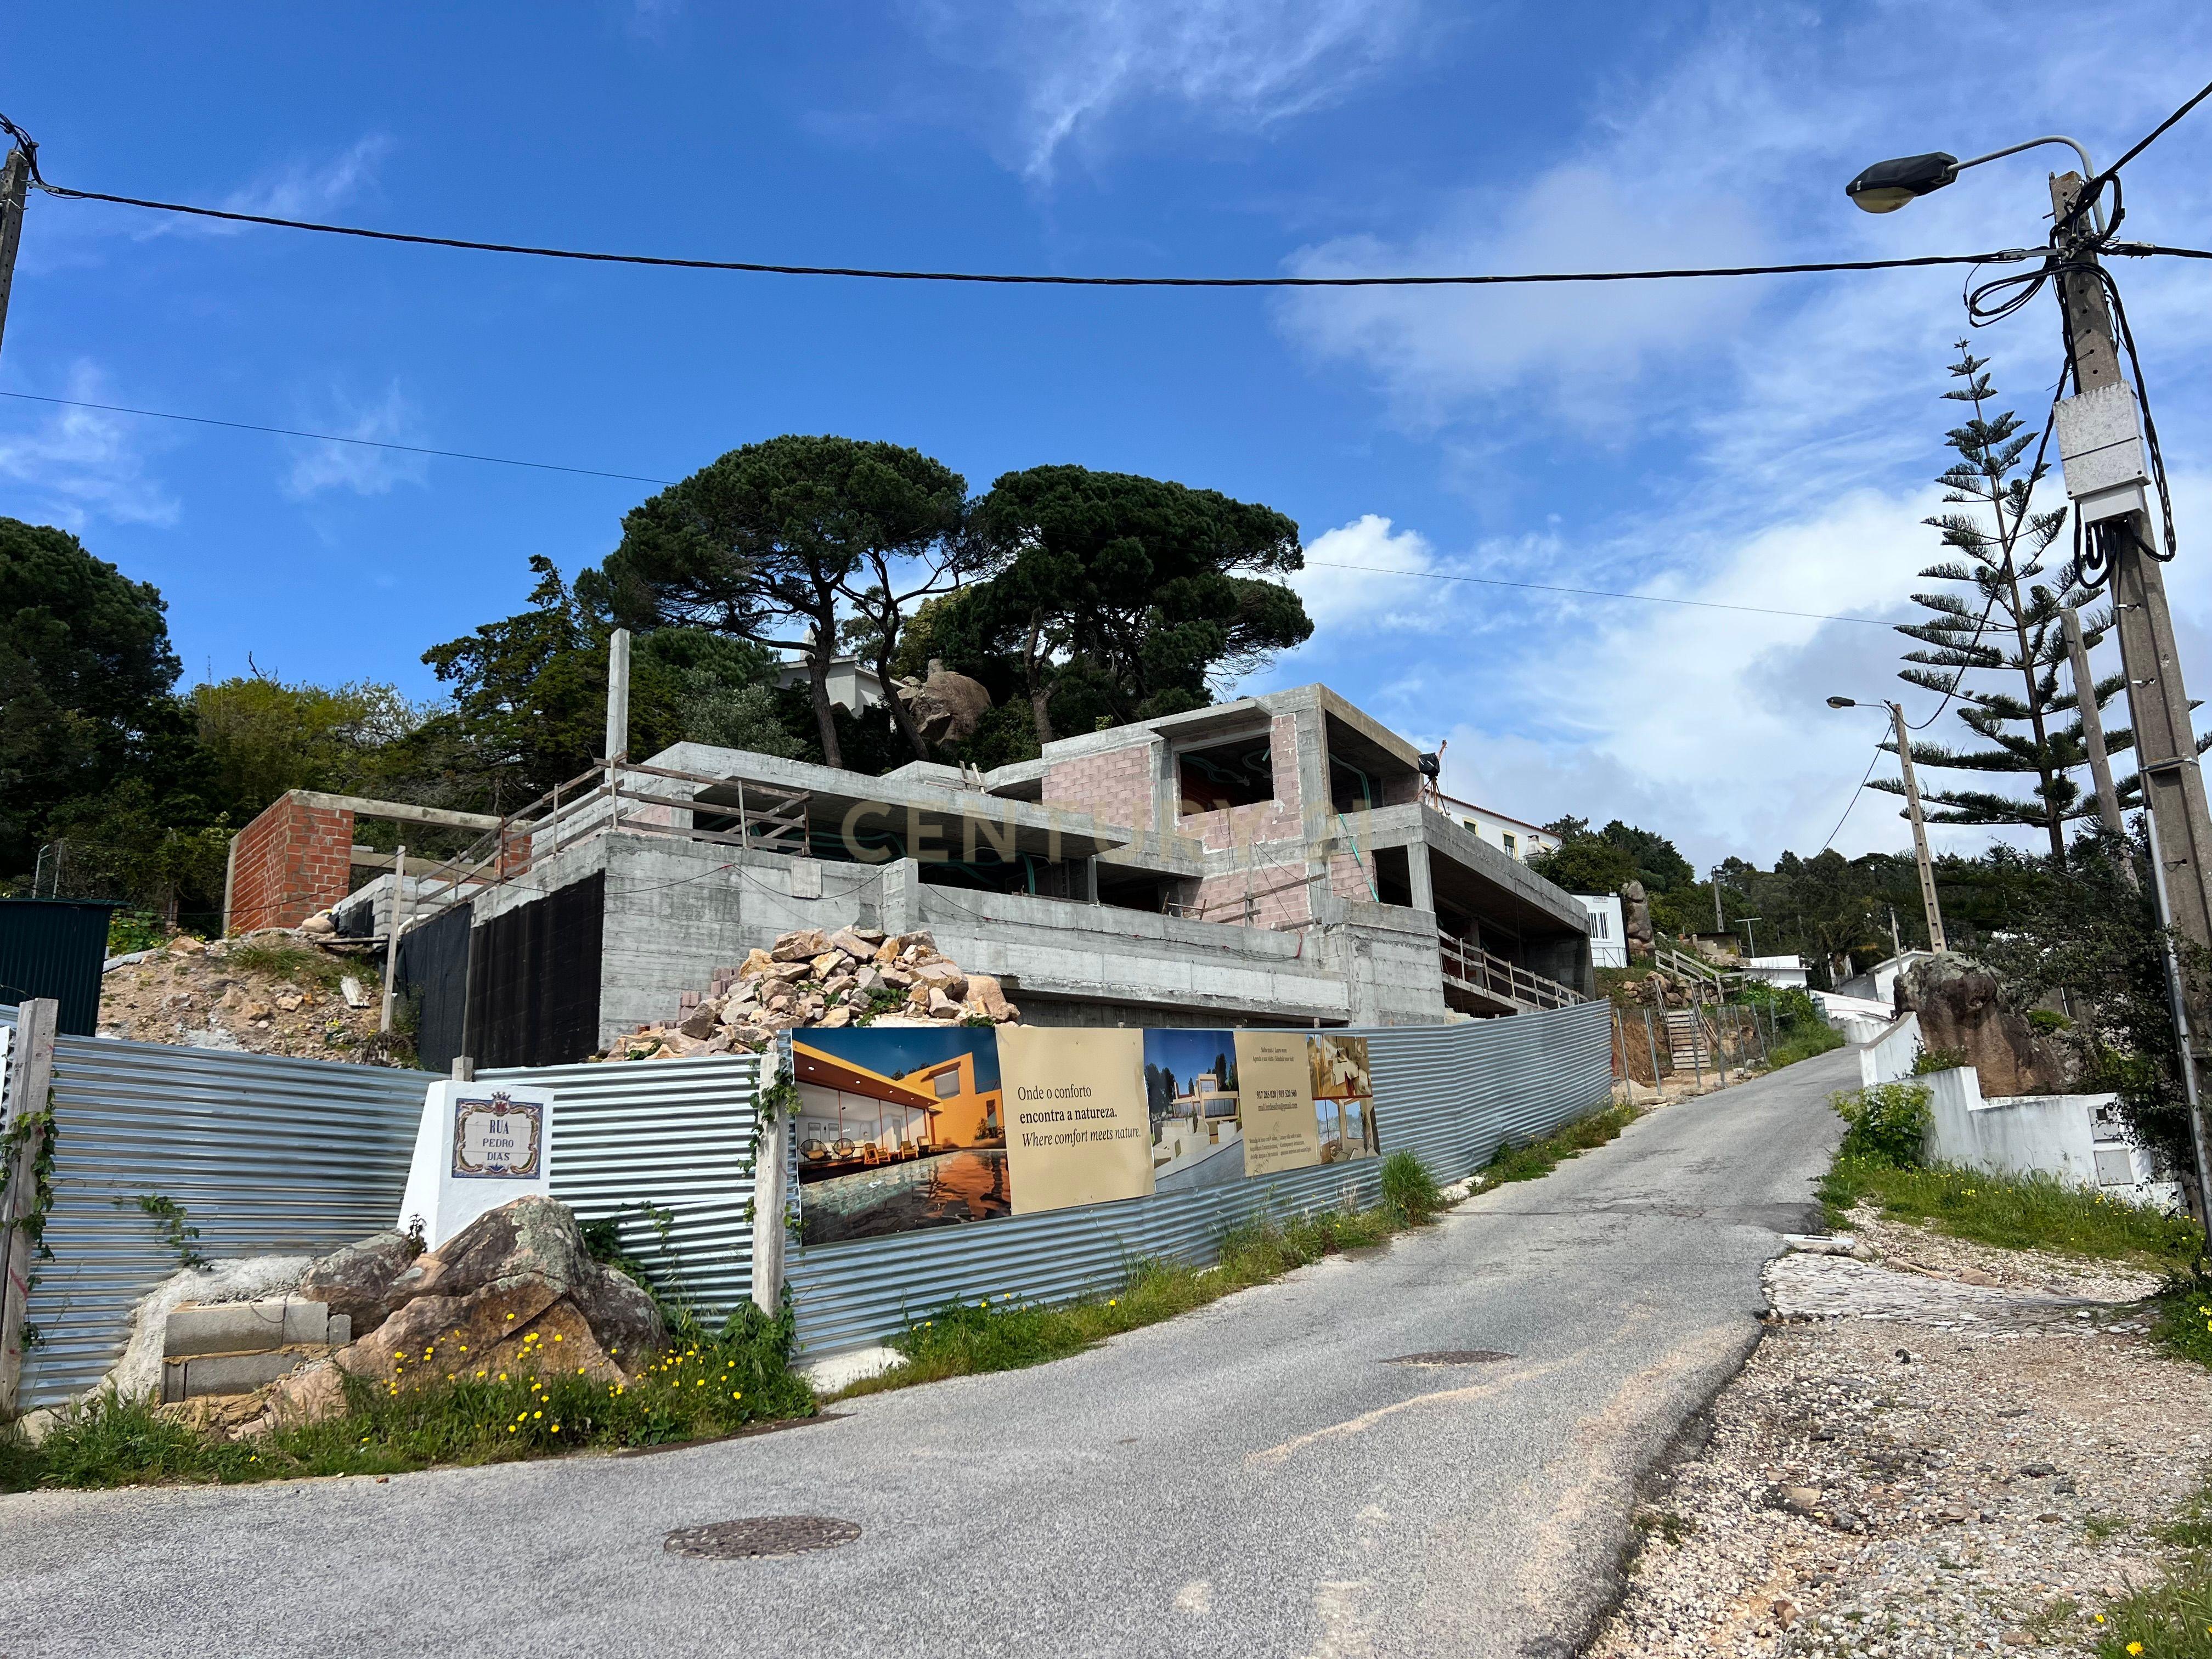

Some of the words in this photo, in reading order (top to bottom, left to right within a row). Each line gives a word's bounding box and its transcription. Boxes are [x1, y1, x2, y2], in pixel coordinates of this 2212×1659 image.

[1018, 1085, 1044, 1101] Onde
[1046, 1088, 1052, 1099] o
[1054, 1084, 1092, 1099] conforto
[1020, 1109, 1065, 1124] encontra
[1067, 1110, 1073, 1121] a
[1075, 1107, 1118, 1120] natureza.
[489, 1119, 509, 1135] RUA
[482, 1138, 514, 1148] PEDRO
[1022, 1132, 1053, 1148] Where
[1054, 1128, 1088, 1148] comfort
[1090, 1128, 1113, 1142] meets
[1115, 1126, 1141, 1139] nature.
[487, 1152, 510, 1161] DIAS
